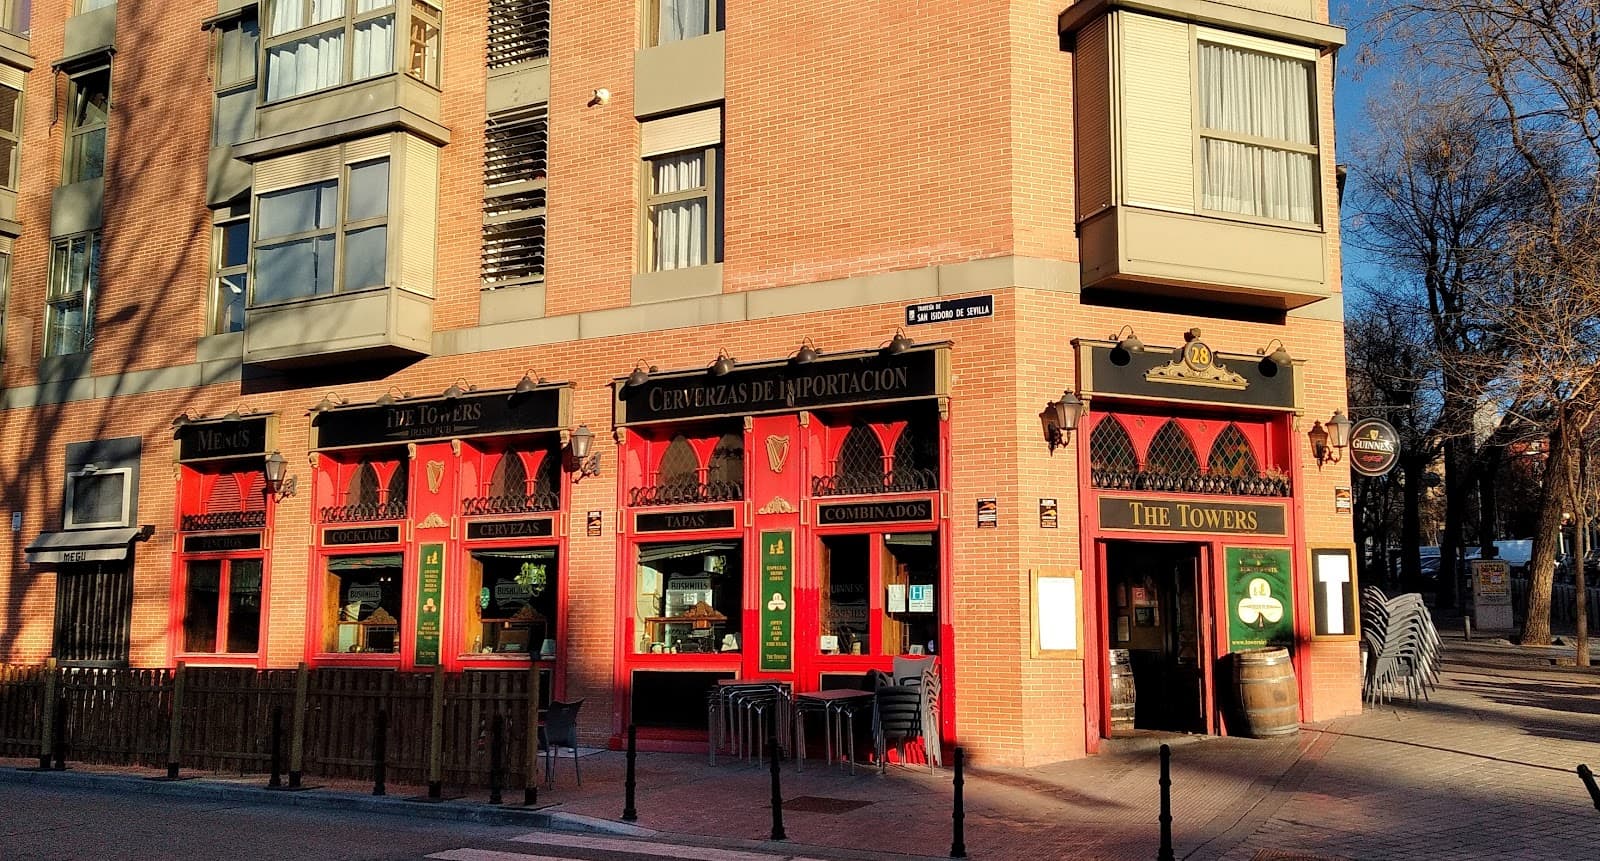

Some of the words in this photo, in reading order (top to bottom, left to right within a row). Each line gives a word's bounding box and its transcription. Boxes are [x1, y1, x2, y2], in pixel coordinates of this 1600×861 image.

[917, 313, 928, 322] SAN
[930, 310, 954, 321] ISIDORO
[956, 308, 964, 317] DE
[966, 305, 990, 316] SEVILLA
[1191, 346, 1208, 365] 28
[648, 382, 747, 412] CERVERZAS
[751, 380, 774, 402] DE
[778, 366, 908, 400] IMPORTACION
[386, 407, 416, 429] THE
[417, 402, 481, 425] TOWERS
[435, 424, 452, 434] PUB
[197, 428, 251, 452] MENUS
[1352, 438, 1394, 452] GUINNESS
[824, 503, 926, 521] COMBINADOS
[1129, 501, 1171, 526] THE
[1176, 503, 1258, 530] TOWERS
[479, 521, 540, 536] CERVEZAS
[665, 514, 705, 528] TAPAS
[332, 529, 390, 543] COCKTAILS
[831, 584, 865, 593] UINNESS
